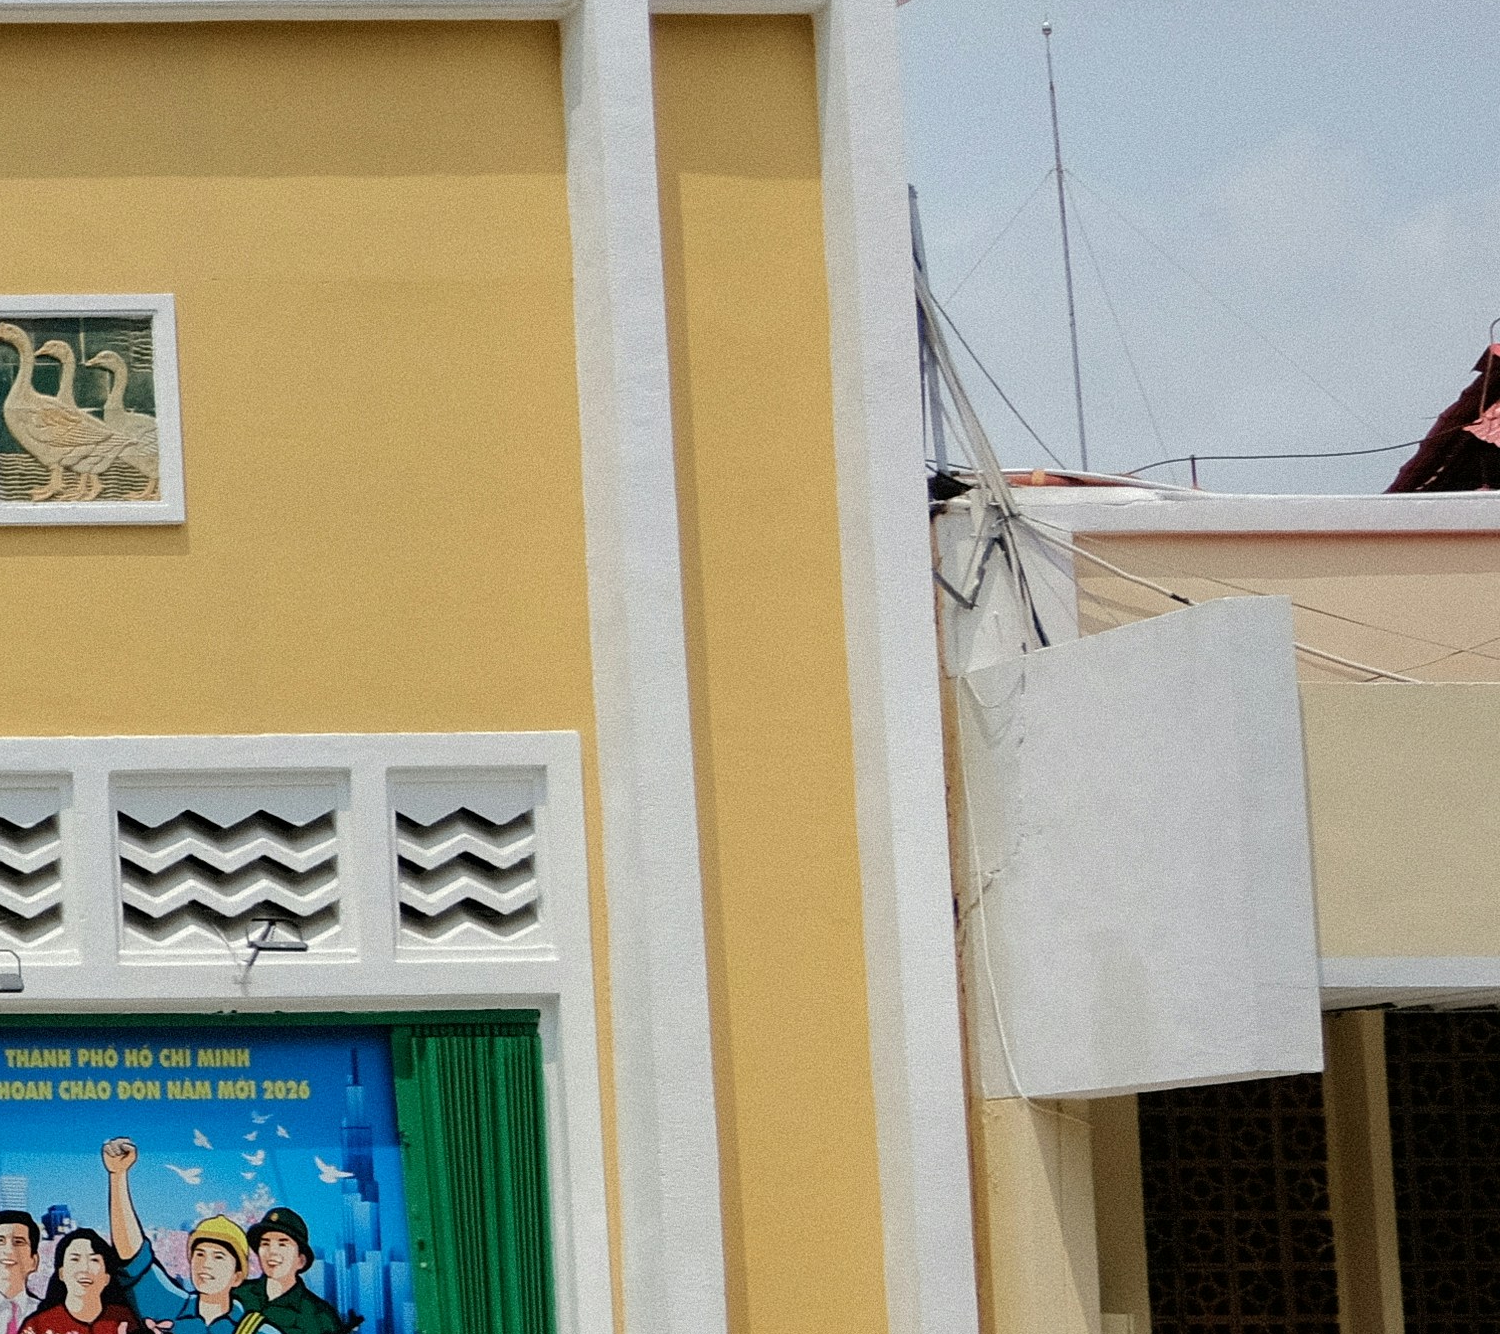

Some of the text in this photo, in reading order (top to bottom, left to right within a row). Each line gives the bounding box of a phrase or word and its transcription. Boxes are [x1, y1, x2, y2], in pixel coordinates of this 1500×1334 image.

[158, 1045, 191, 1068] CHÍ
[197, 1048, 250, 1068] MINH
[58, 1076, 112, 1101] CHÀO
[261, 1079, 310, 1100] 2026
